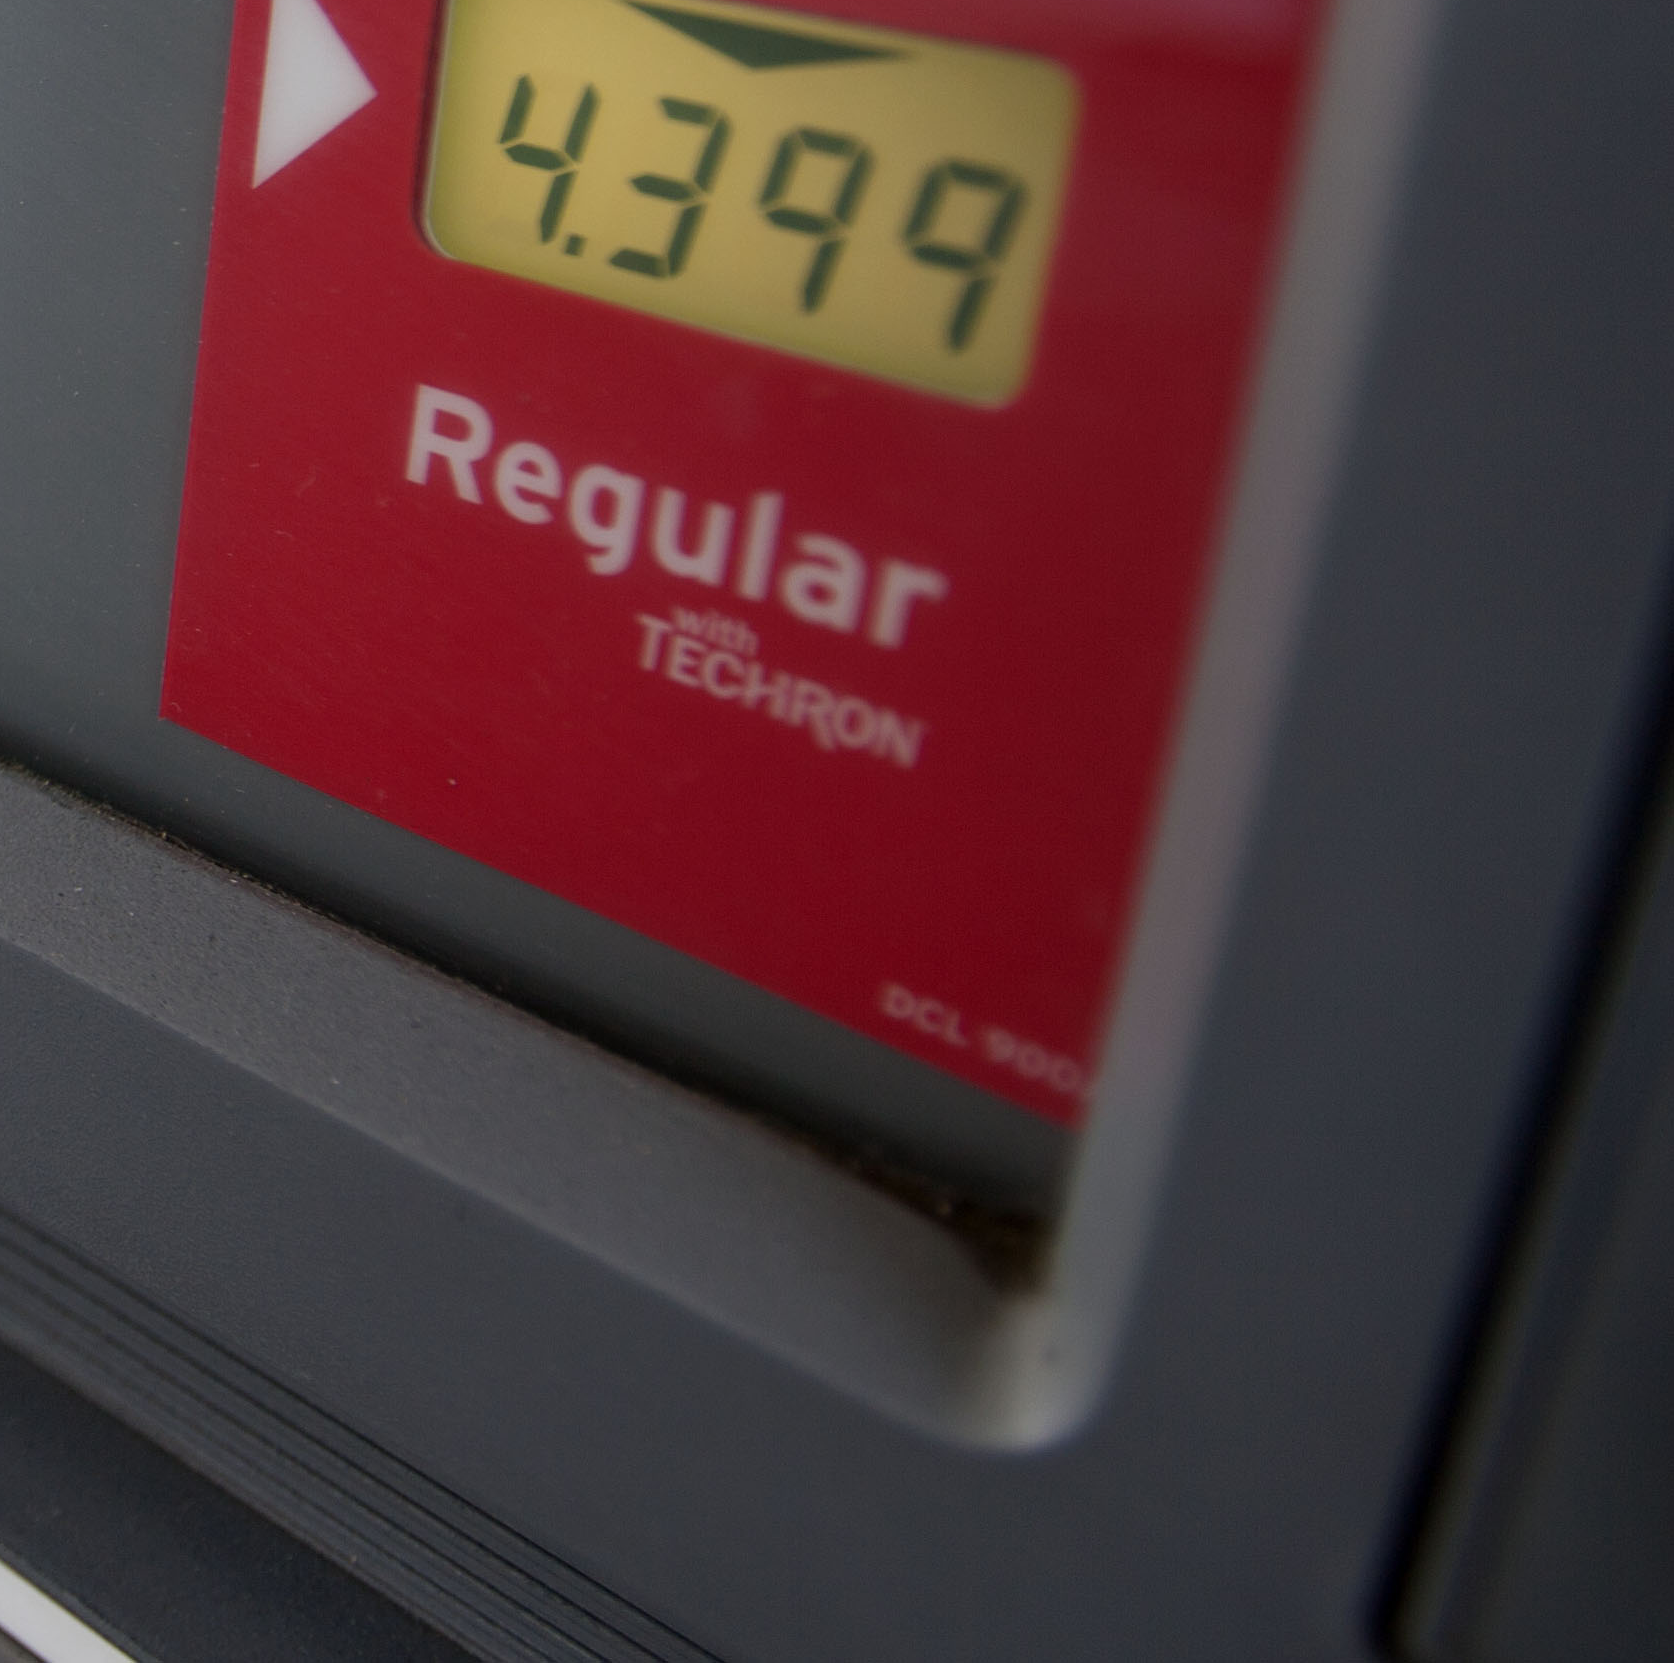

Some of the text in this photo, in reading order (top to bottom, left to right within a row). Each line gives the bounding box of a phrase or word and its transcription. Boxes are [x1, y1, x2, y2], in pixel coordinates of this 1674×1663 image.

[496, 71, 1032, 357] 4.399
[403, 381, 951, 651] Regular
[635, 611, 925, 770] TECHRON
[672, 605, 762, 658] with
[982, 1025, 1094, 1095] 900
